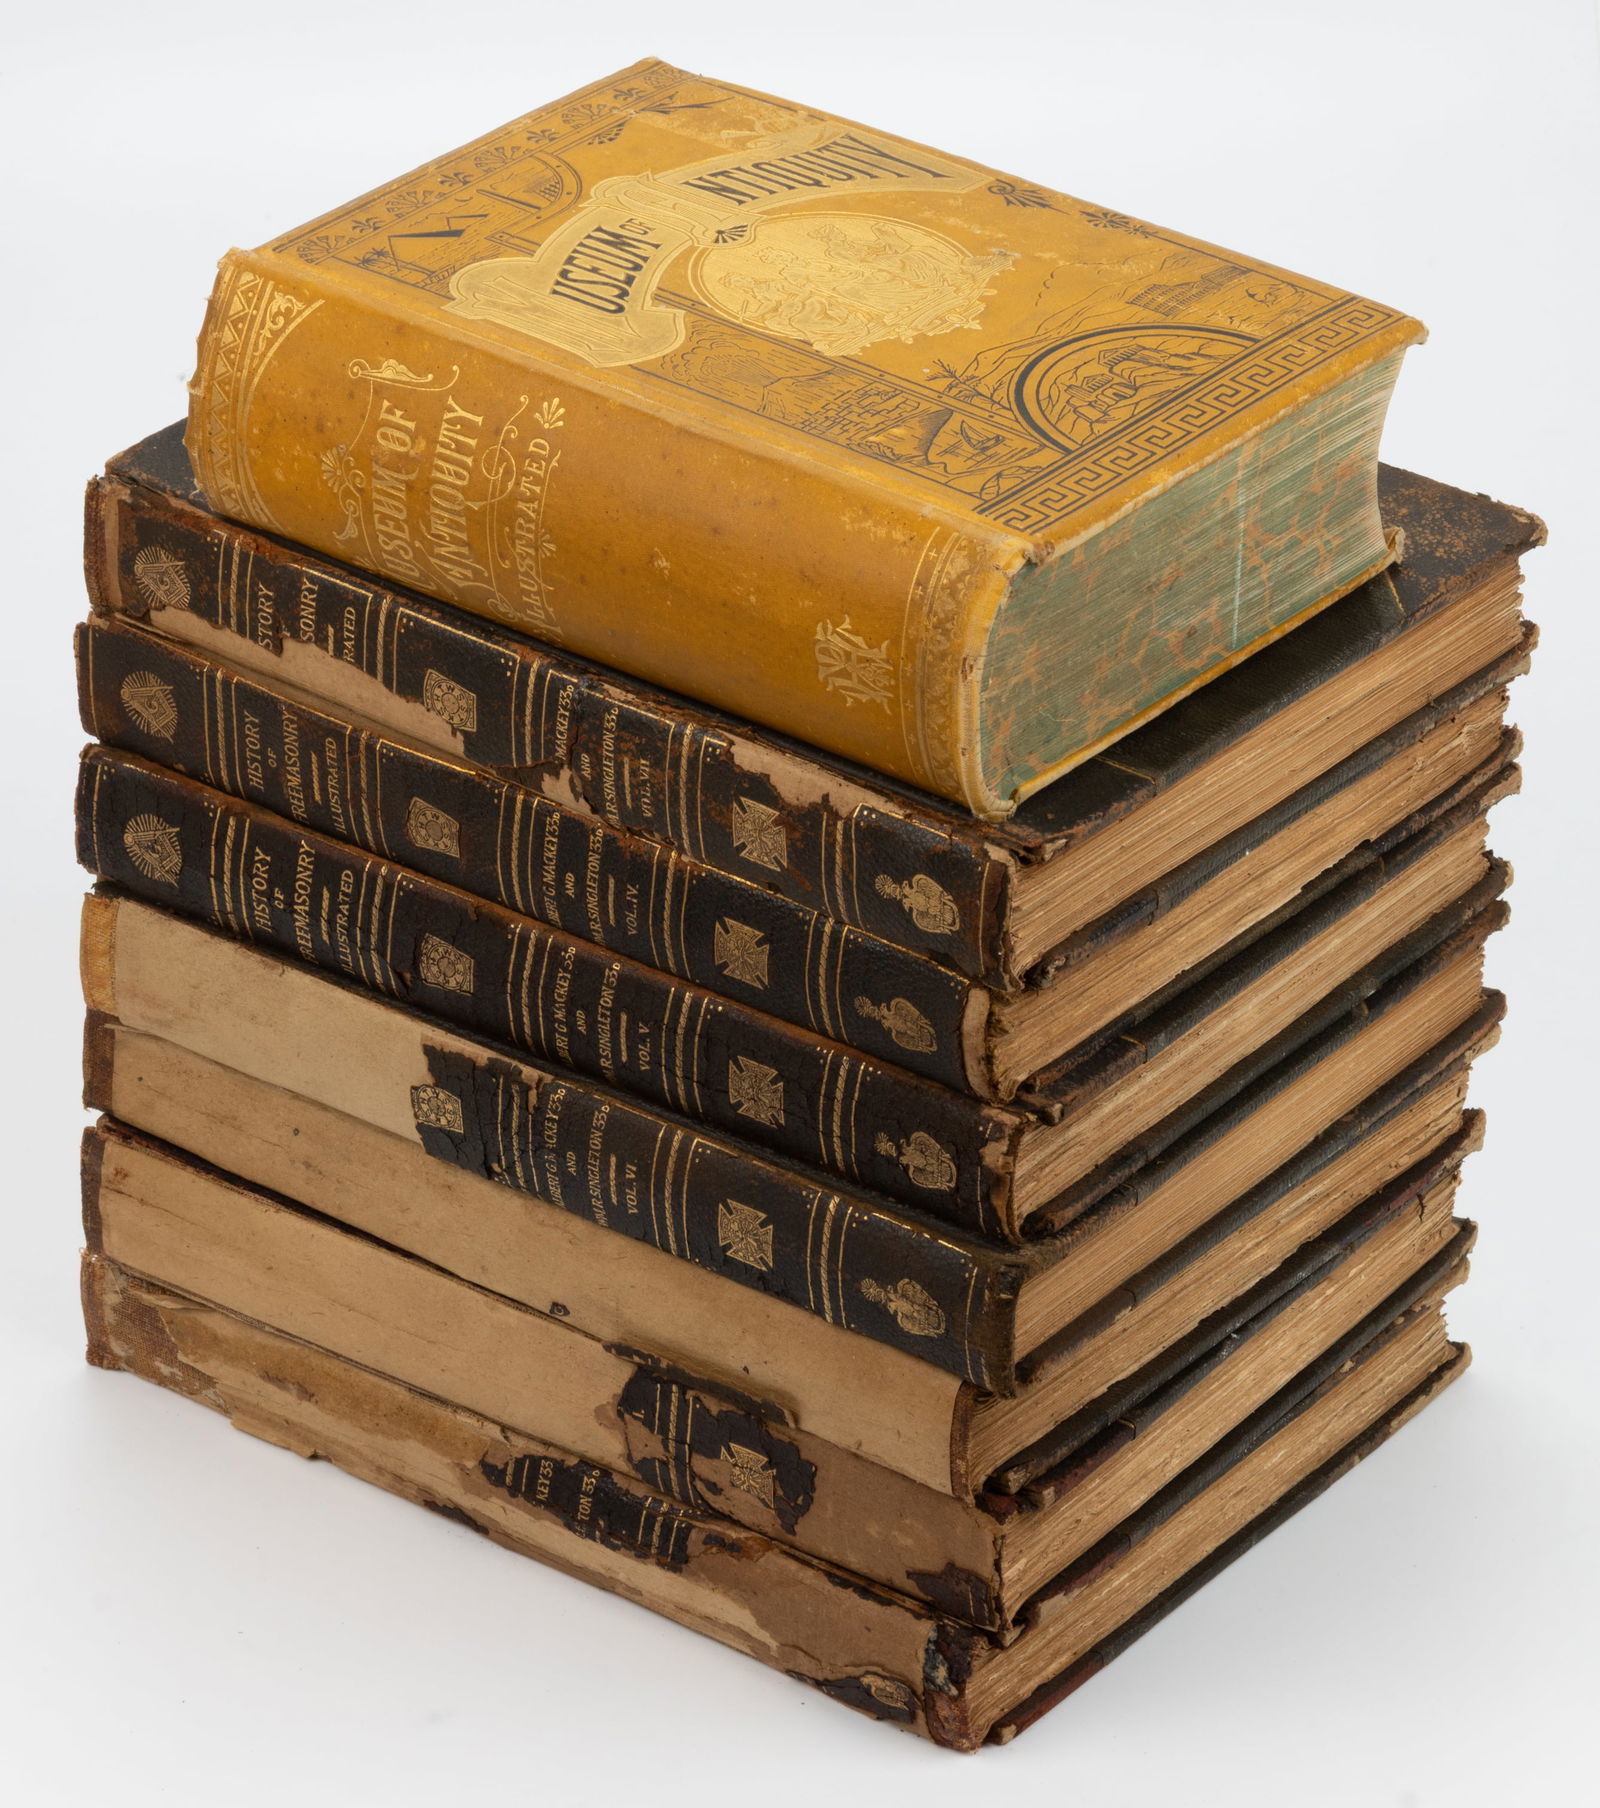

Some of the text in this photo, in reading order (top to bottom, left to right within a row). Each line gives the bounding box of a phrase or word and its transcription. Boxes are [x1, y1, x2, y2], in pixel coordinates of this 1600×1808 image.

[618, 217, 657, 236] OF
[376, 398, 417, 453] OF
[428, 394, 485, 587] ANTIQUITY
[514, 437, 562, 639] ILLUSTRATED
[244, 711, 265, 793] HISTORY
[267, 747, 277, 768] OF
[554, 705, 570, 762] MACKEY
[325, 737, 348, 835] ILLUSTRATED
[581, 752, 592, 780] AND
[543, 833, 558, 885] MACKEY
[565, 871, 575, 898] AND
[252, 846, 273, 934] HISTORY
[274, 887, 285, 909] OF
[336, 869, 355, 975] ILLUSTRATED
[552, 968, 572, 1022] MACKEY
[576, 1010, 587, 1035] AND
[566, 1151, 577, 1176] AND
